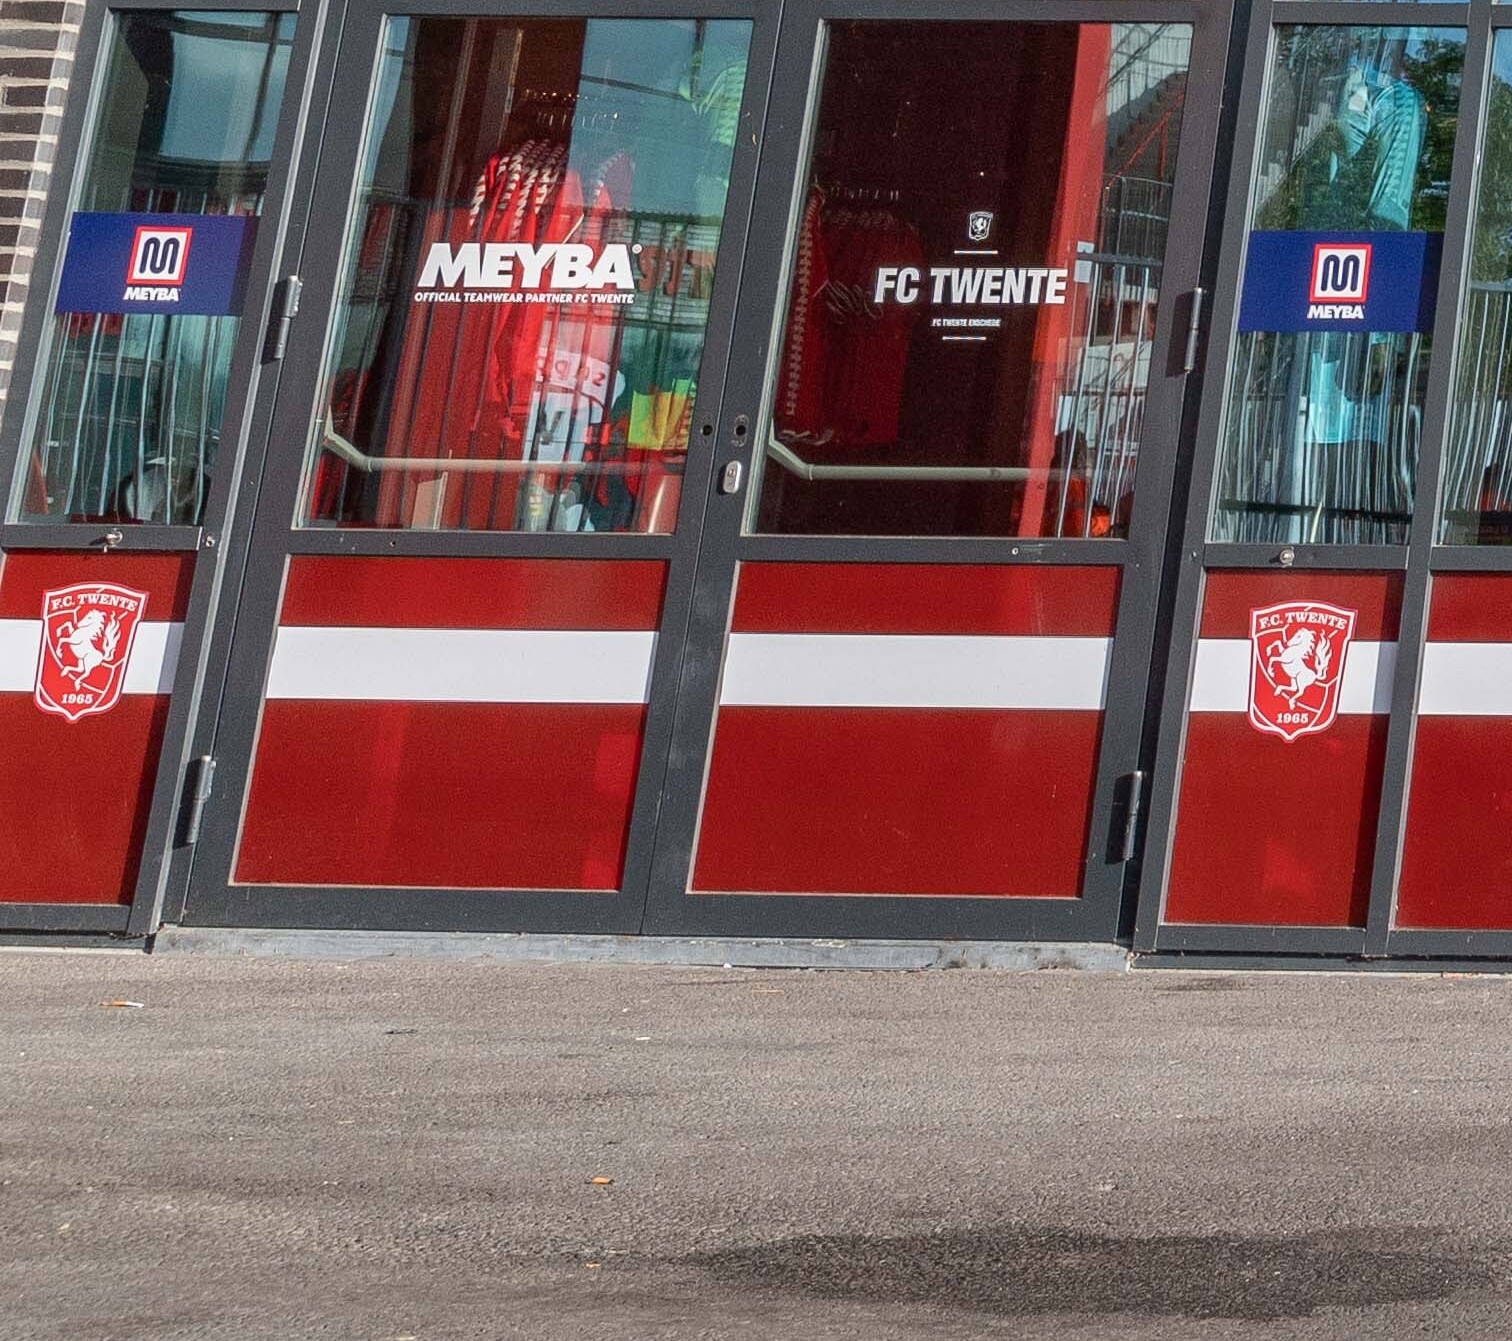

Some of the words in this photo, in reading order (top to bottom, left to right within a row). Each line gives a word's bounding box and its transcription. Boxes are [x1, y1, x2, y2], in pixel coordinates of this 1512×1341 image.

[418, 242, 635, 289] MEYBA
[874, 267, 921, 304] FC
[930, 267, 1069, 304] TWENTE
[123, 287, 179, 301] MEYBA
[414, 292, 462, 303] OFFICIAL
[463, 292, 521, 304] TEAMWEAR
[525, 293, 572, 304] PARTNER
[574, 293, 588, 304] FC
[590, 294, 634, 304] TWENTE
[1307, 305, 1364, 319] MEYBA
[77, 592, 138, 611] TWENTE
[1285, 611, 1348, 629] TWENTE
[61, 693, 93, 704] 1965
[1276, 712, 1309, 724] 1965
